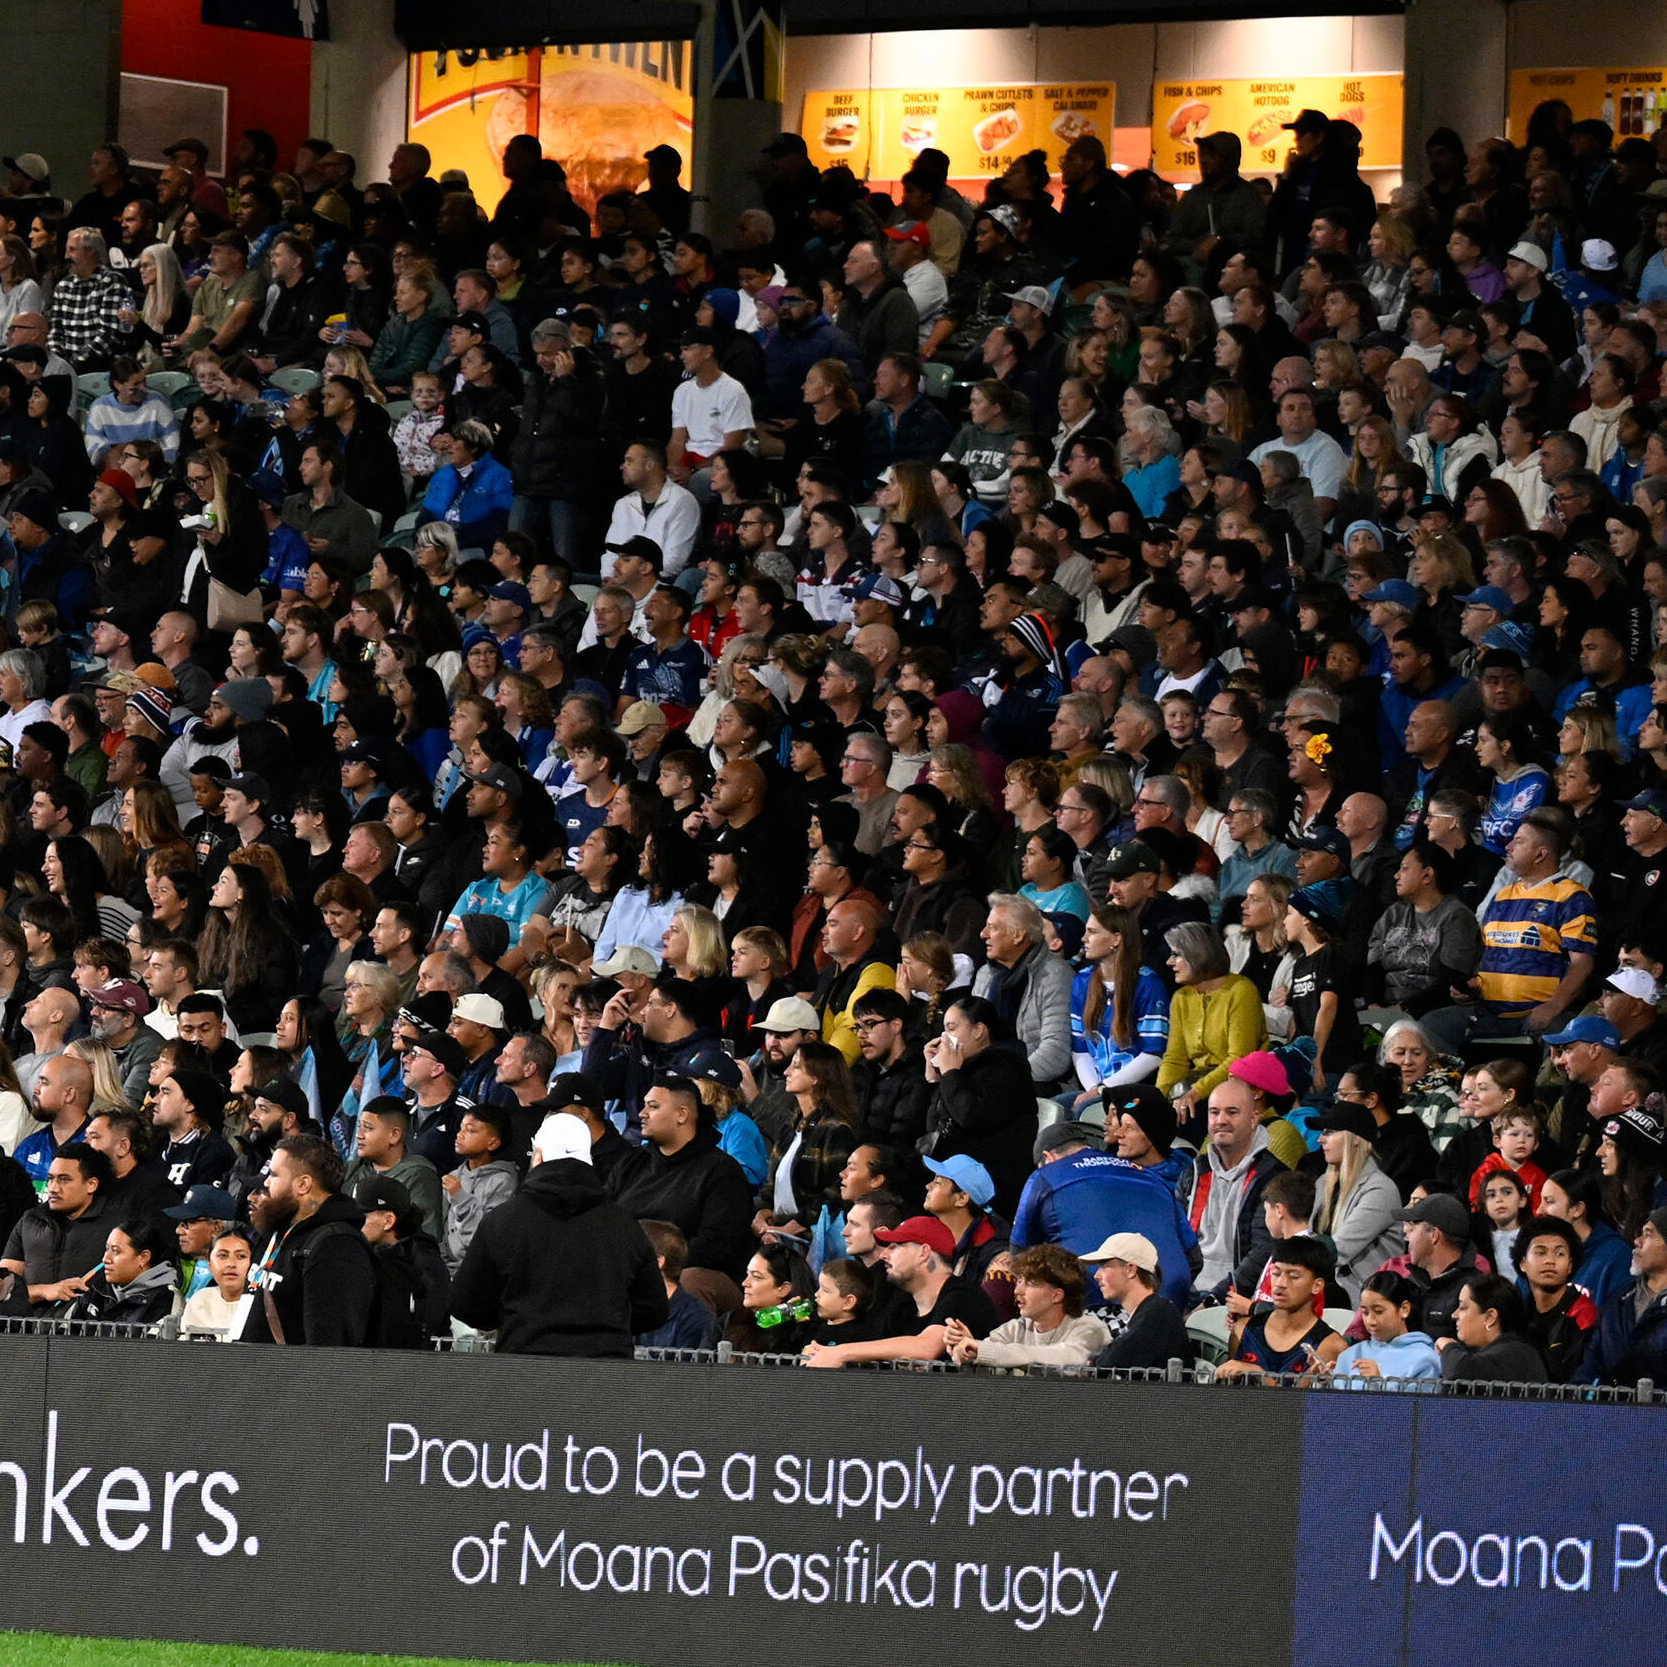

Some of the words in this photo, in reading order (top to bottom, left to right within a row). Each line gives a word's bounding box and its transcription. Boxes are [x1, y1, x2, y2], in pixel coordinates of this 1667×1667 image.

[1195, 86, 1222, 96] CHIPS
[386, 1423, 548, 1490] Proud
[564, 1435, 618, 1494] to
[636, 1434, 705, 1499] be
[722, 1453, 755, 1500] a
[773, 1446, 954, 1520] supply
[968, 1458, 1188, 1526] partner
[452, 1521, 510, 1584] of
[520, 1526, 711, 1596] Moana
[729, 1528, 936, 1609] Pasifika
[954, 1552, 1118, 1631] rugby
[1369, 1513, 1591, 1591] Moana
